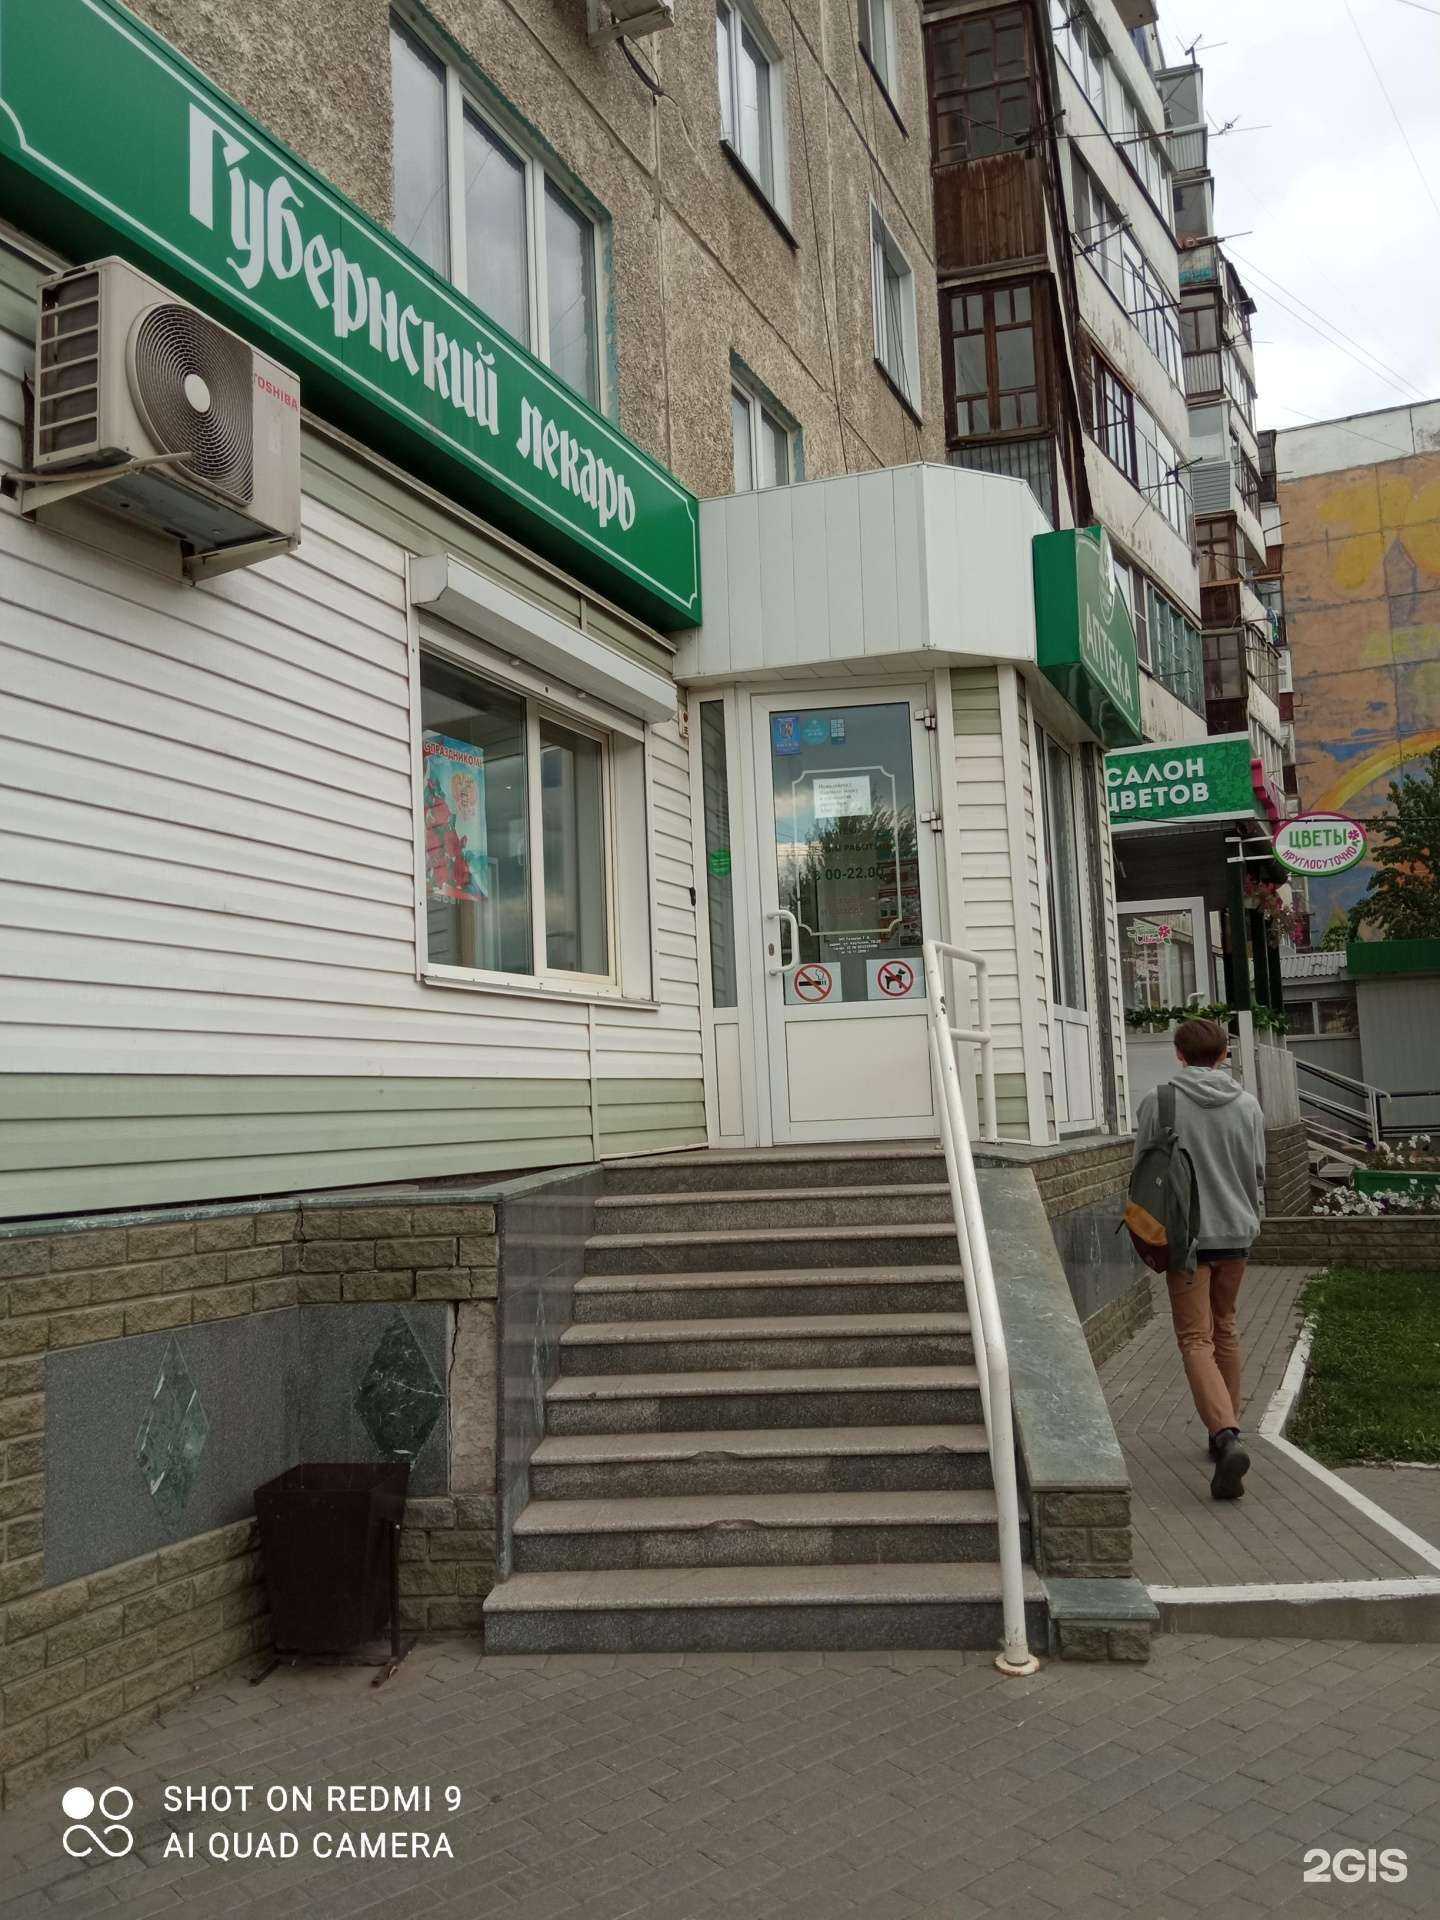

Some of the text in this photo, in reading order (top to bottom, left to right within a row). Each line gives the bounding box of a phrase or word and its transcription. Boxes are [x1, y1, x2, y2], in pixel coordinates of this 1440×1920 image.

[189, 101, 636, 532] Губернский лекарь
[253, 372, 299, 411] TOSHIBA
[1086, 609, 1134, 711] АПТЕКА
[1105, 757, 1205, 787] САЛОН
[1289, 828, 1347, 849] ЦВЕТЫ
[1282, 846, 1357, 870] КРУГЛОСУТОЧНО
